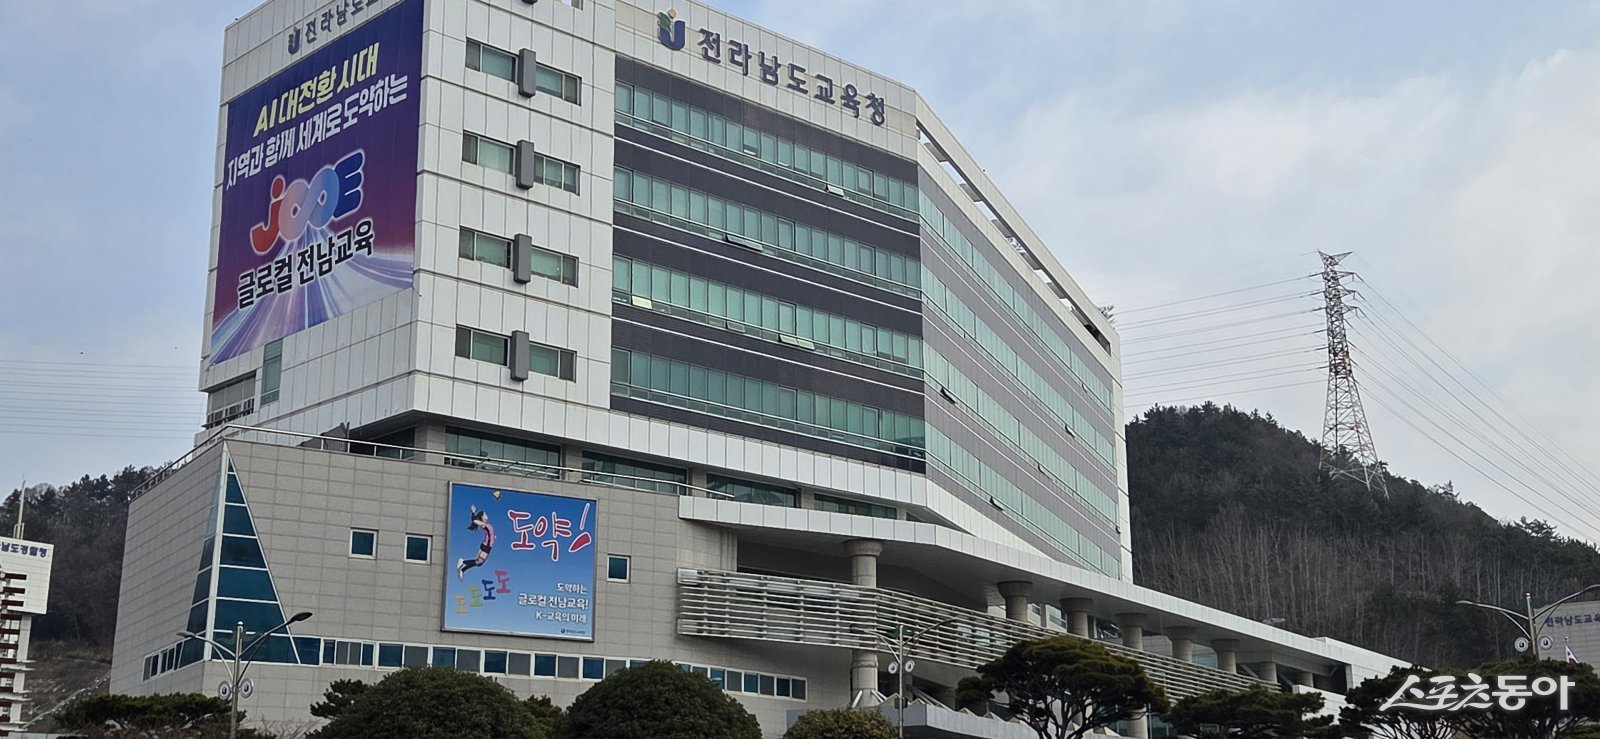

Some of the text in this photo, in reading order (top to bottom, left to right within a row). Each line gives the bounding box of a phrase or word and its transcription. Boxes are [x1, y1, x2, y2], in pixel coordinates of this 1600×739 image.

[253, 42, 380, 138] AI 대전환 시대
[697, 28, 886, 126] 전라남도교육청
[226, 73, 408, 191] 지역과 함께 세계로 도약하는
[237, 219, 374, 310] 글로컬 전남교육
[0, 541, 48, 558] 남도경찰청
[508, 503, 592, 562] 도약!
[518, 592, 589, 610] 글로컬 전남교육!
[557, 582, 588, 594] 도약하는
